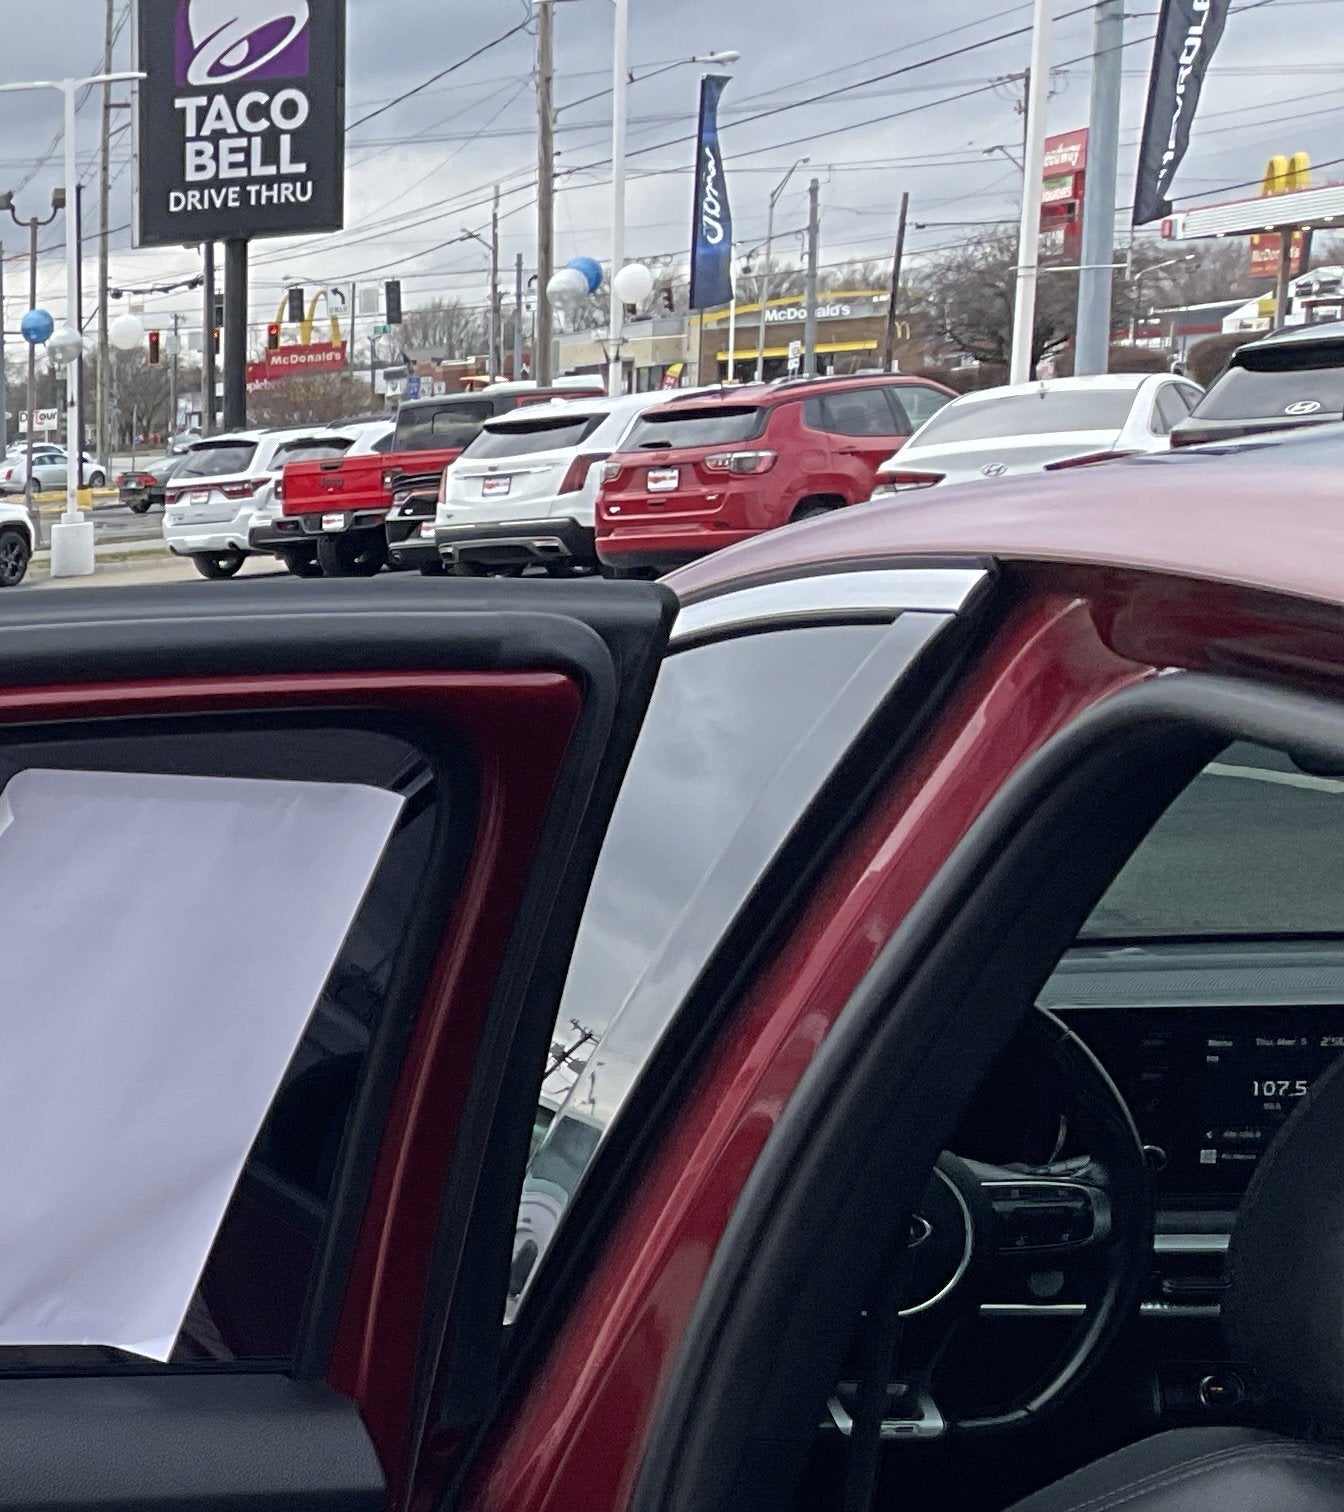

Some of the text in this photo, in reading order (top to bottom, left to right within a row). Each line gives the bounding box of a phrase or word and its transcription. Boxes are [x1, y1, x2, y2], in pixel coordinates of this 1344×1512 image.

[174, 88, 309, 137] TACO
[185, 134, 307, 182] BELL
[1043, 143, 1081, 167] eedway
[169, 180, 313, 212] DRIVE THRU
[764, 303, 851, 322] McDoald's
[270, 351, 342, 366] McDonald's
